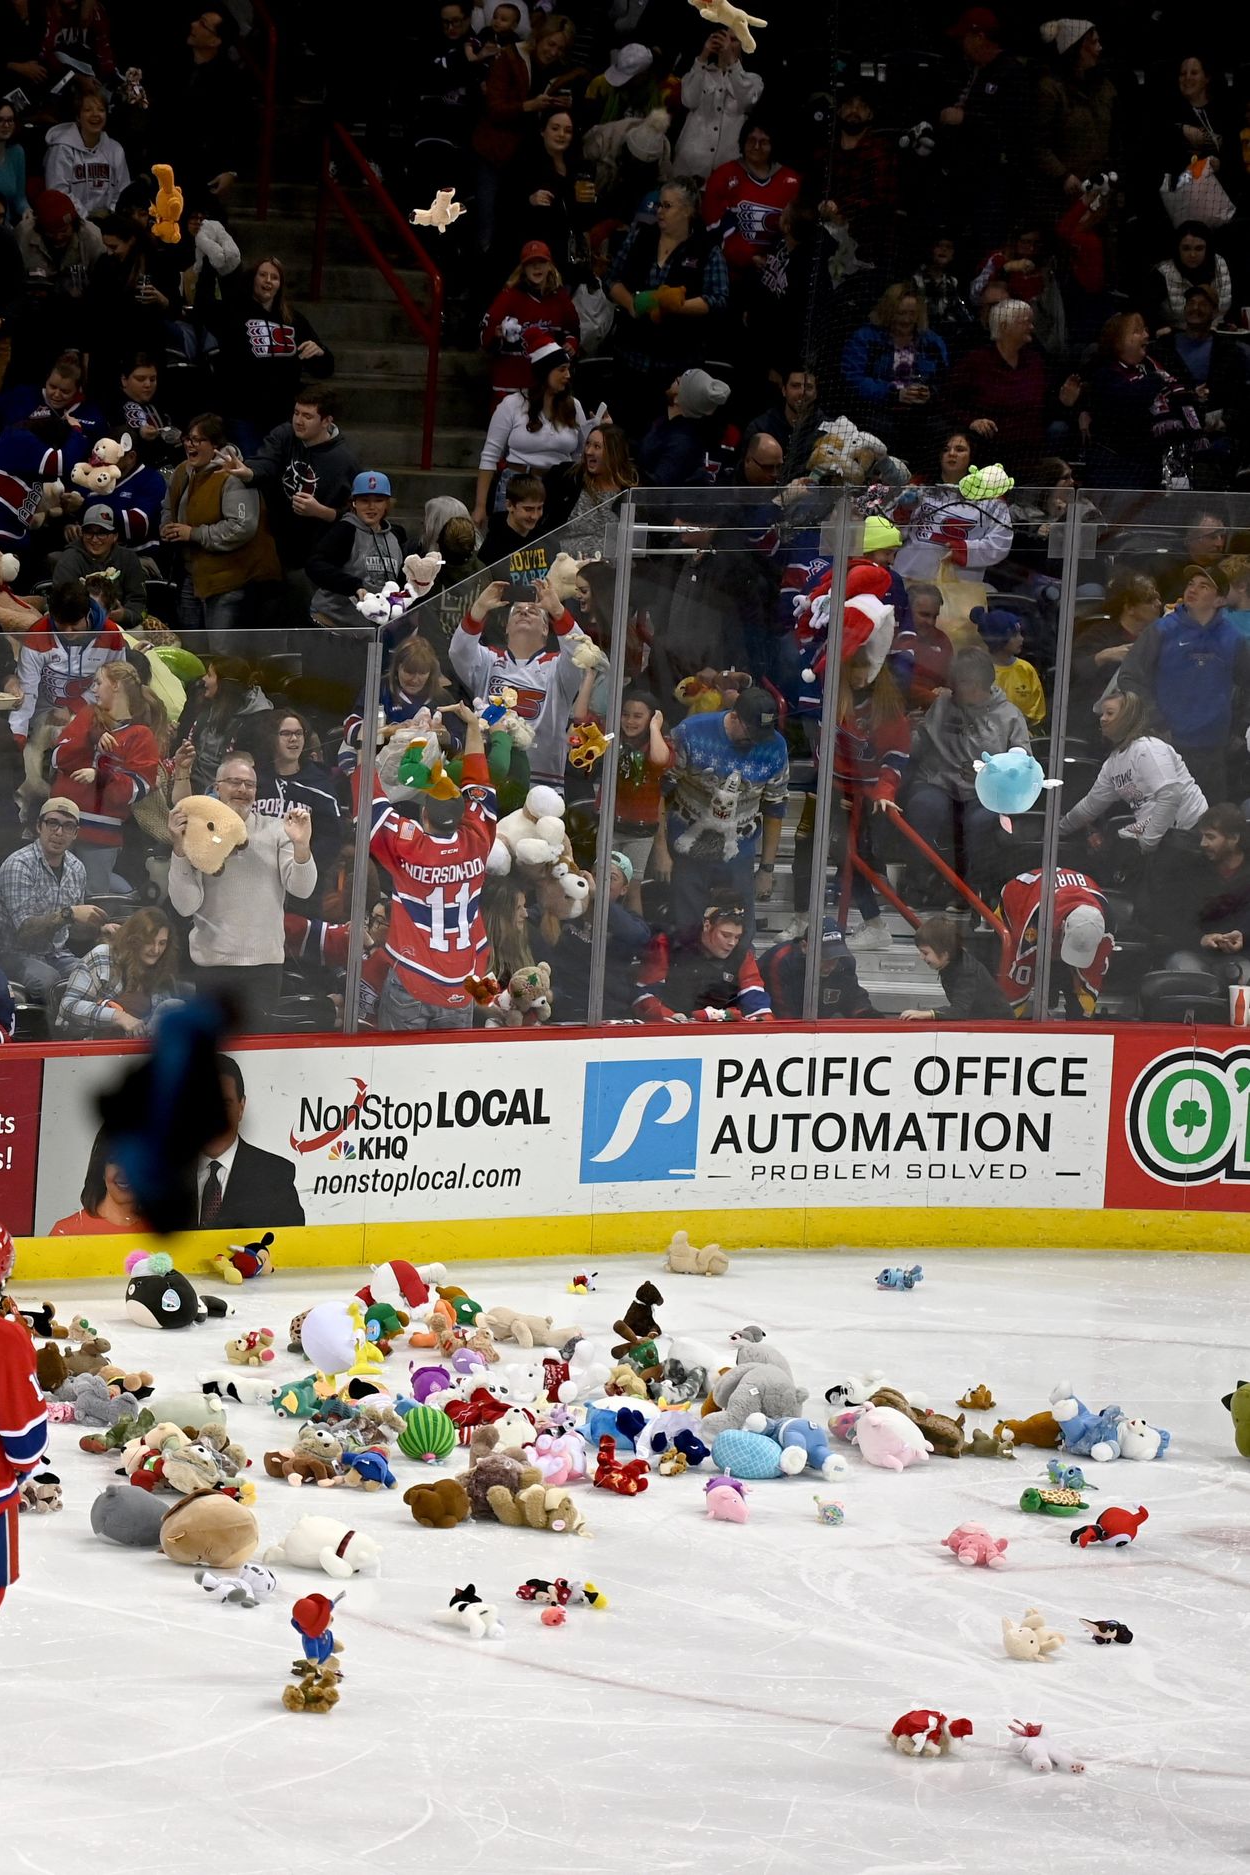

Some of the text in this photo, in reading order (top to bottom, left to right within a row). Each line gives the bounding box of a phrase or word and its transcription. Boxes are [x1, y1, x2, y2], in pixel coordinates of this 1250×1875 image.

[440, 847, 459, 856] CCM
[425, 882, 472, 951] 11
[716, 1056, 1088, 1098] PACIFIC OFFICE
[299, 1087, 550, 1136] NonStopLOCAL
[358, 1135, 408, 1161] KHQ
[710, 1111, 1051, 1154] AUTOMATION
[313, 1163, 522, 1197] nonstoplocal.com
[751, 1163, 1028, 1180] PROBLEM SOLVED
